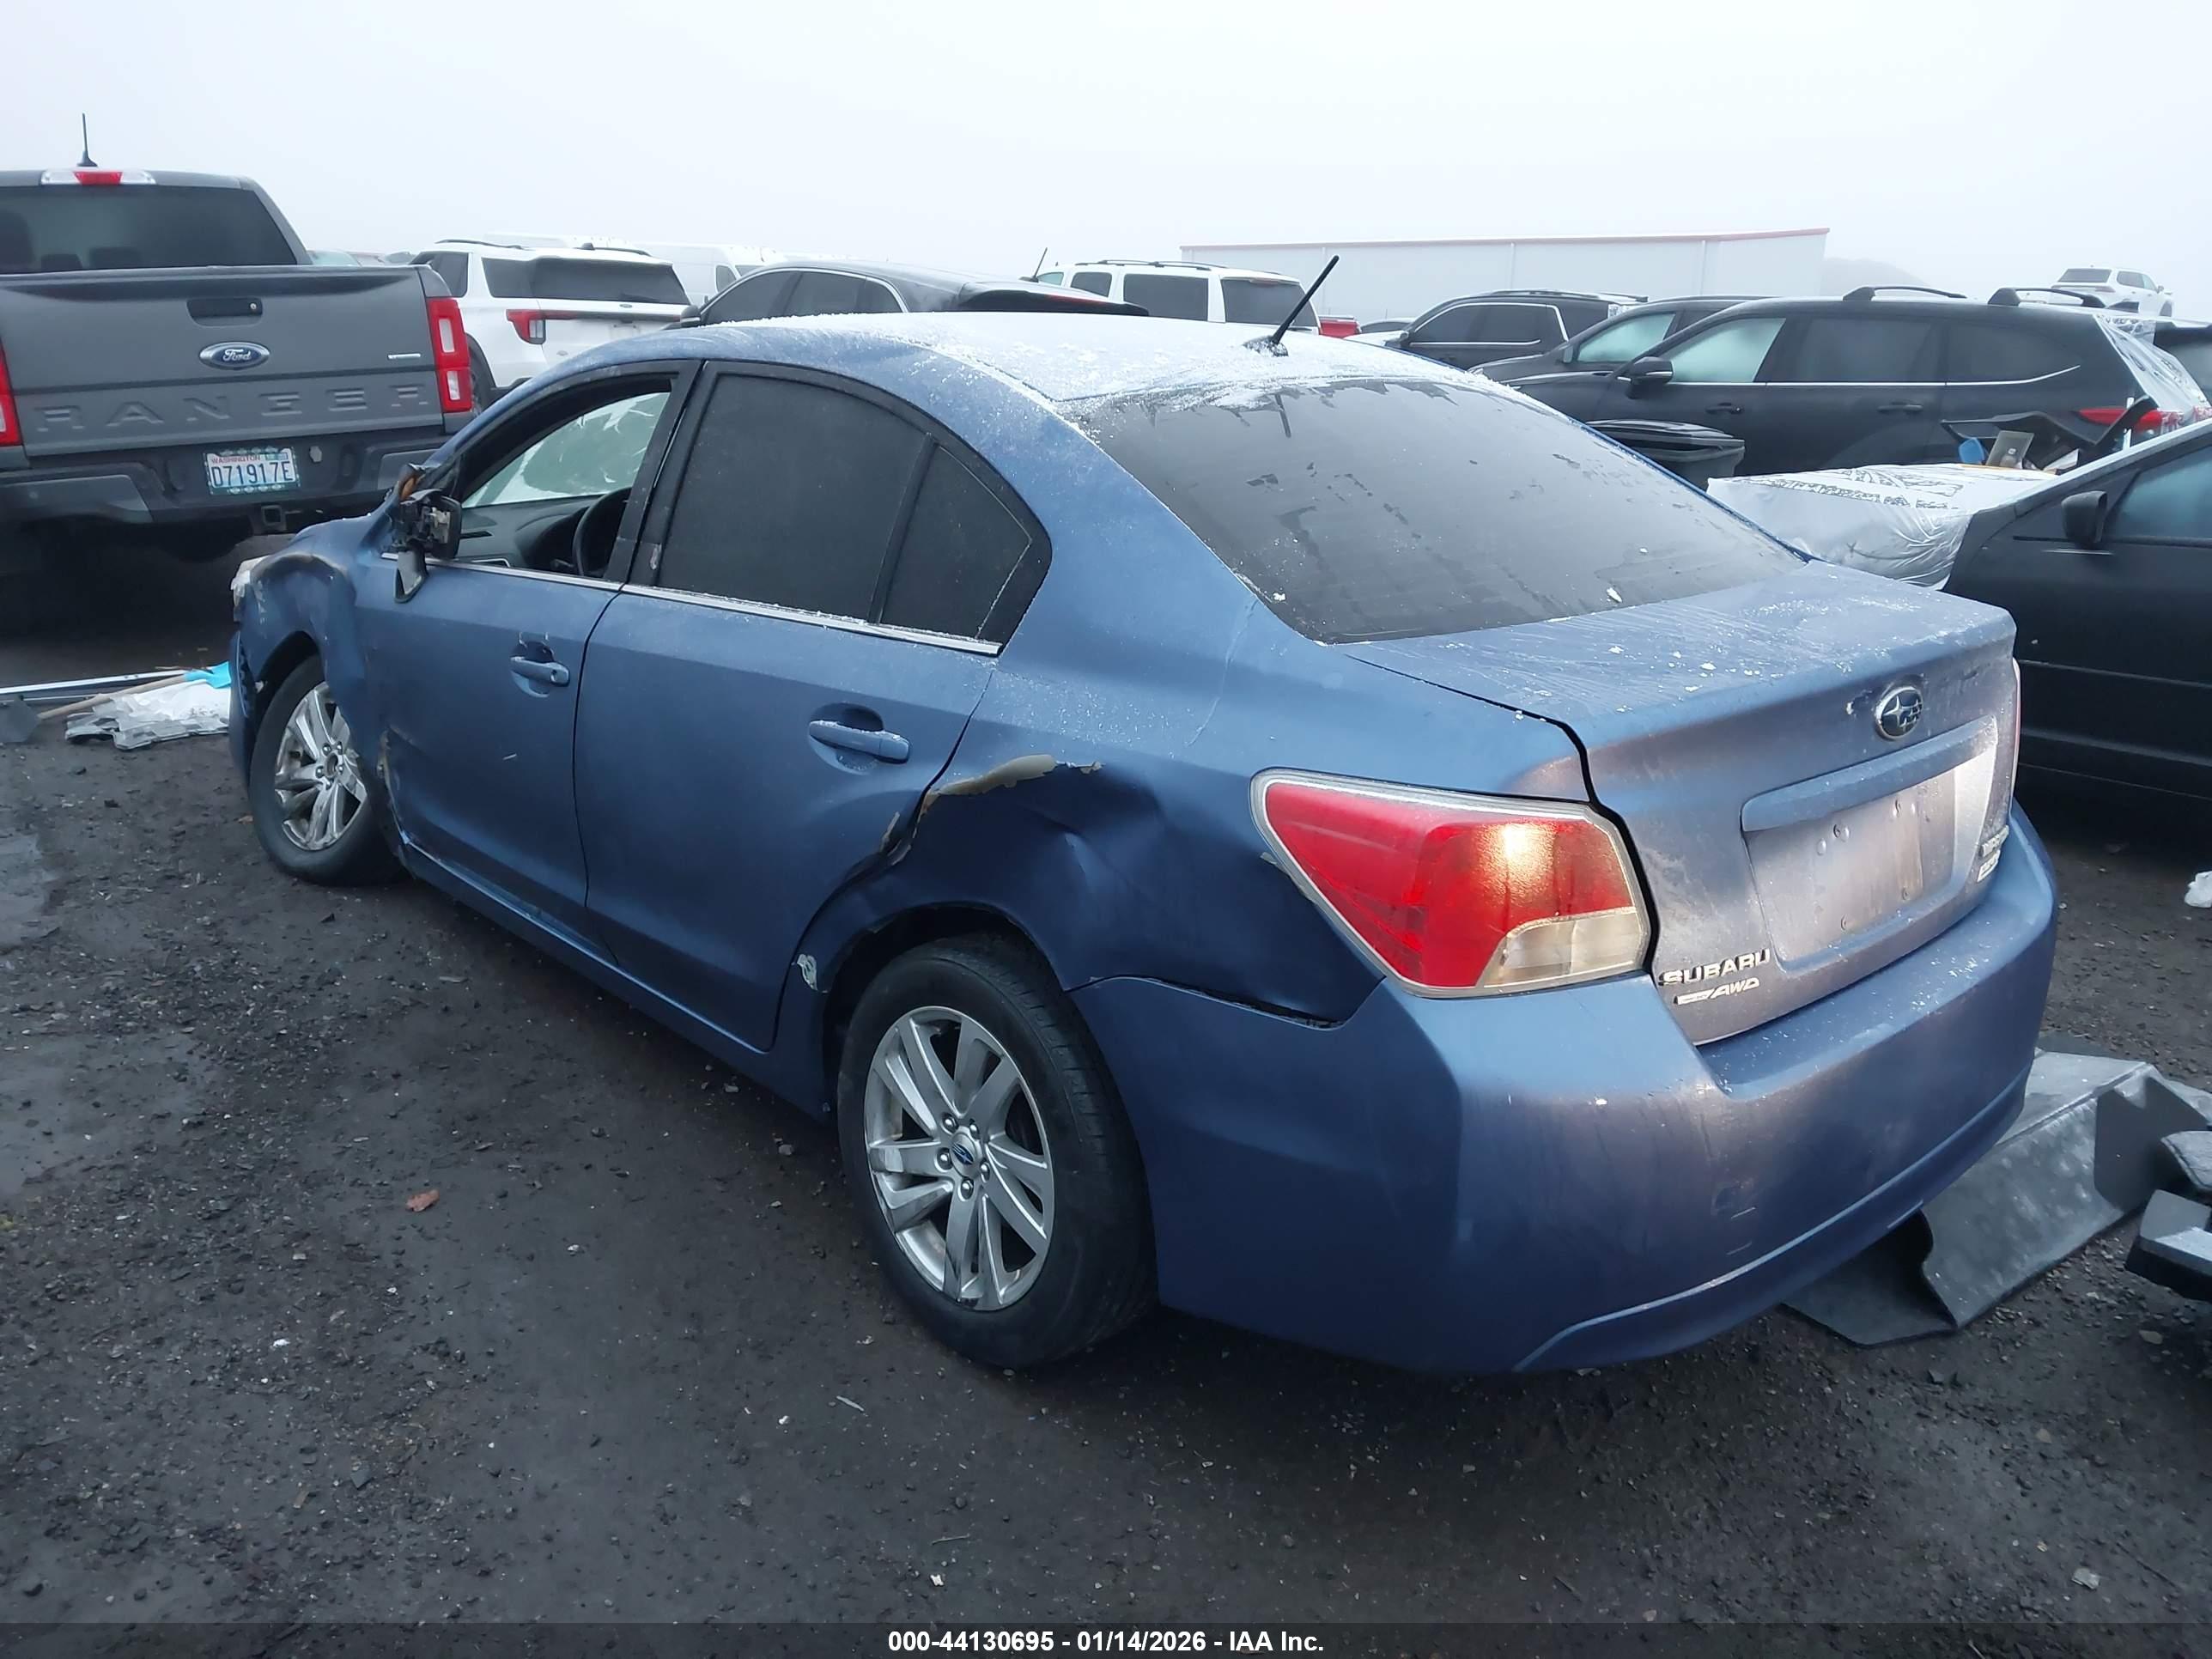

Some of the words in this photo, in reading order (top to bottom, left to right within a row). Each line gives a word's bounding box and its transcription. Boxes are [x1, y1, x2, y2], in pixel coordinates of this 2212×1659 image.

[222, 348, 252, 362] Ford
[211, 461, 293, 487] D71917E
[1659, 948, 1771, 986] SUBARU
[1711, 977, 1760, 1000] AWD
